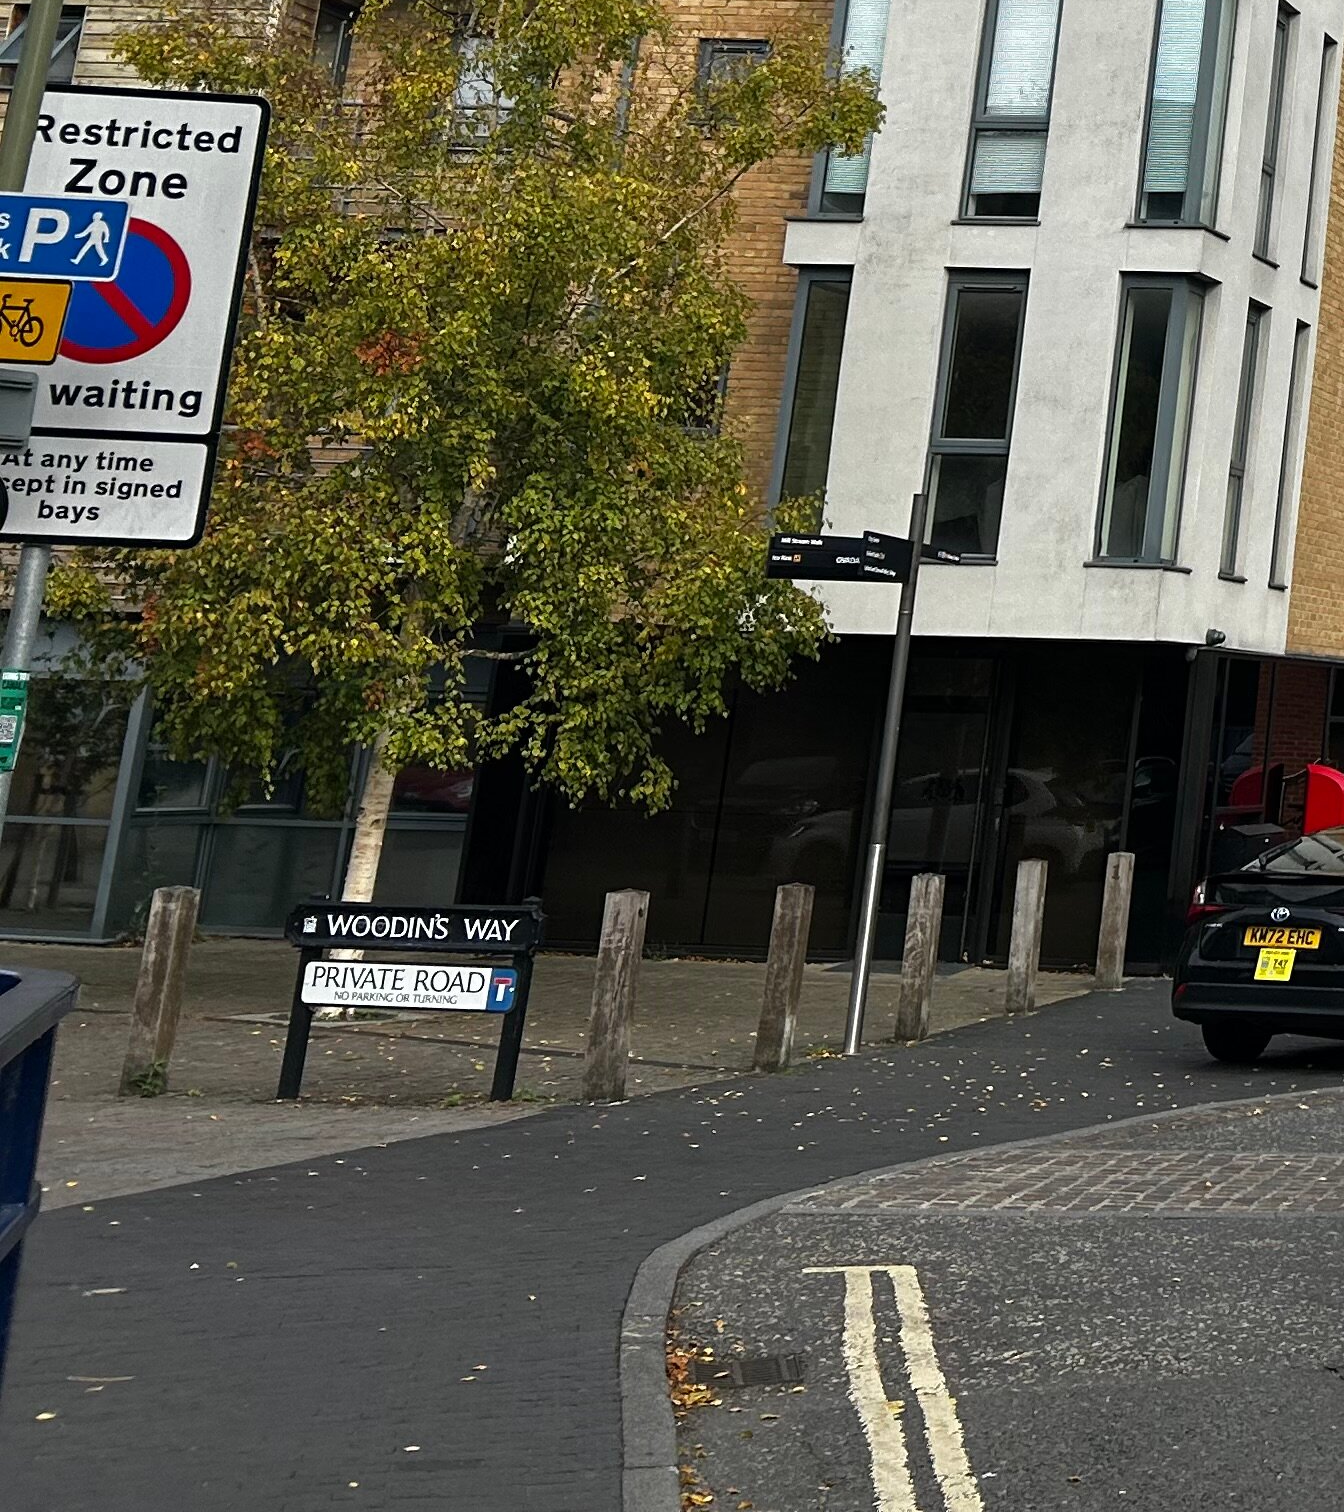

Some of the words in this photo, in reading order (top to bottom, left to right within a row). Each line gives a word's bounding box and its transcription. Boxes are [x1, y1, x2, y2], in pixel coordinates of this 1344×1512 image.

[36, 114, 243, 153] Restricted
[64, 157, 188, 199] Zone
[18, 207, 70, 263] P
[49, 379, 203, 418] waiting
[40, 453, 89, 473] any
[96, 451, 154, 472] time
[0, 474, 56, 496] cept
[63, 475, 86, 494] in
[94, 477, 183, 500] signed
[37, 500, 100, 524] bays
[327, 913, 450, 940] WOODIN'S
[464, 918, 520, 941] WAY
[1286, 928, 1316, 945] EHC
[311, 966, 406, 991] PRIVATE
[413, 969, 485, 993] ROAD
[334, 991, 350, 1001] NO
[351, 992, 394, 1003] PARKING
[395, 993, 410, 1003] OR
[413, 994, 458, 1005] TURNING
